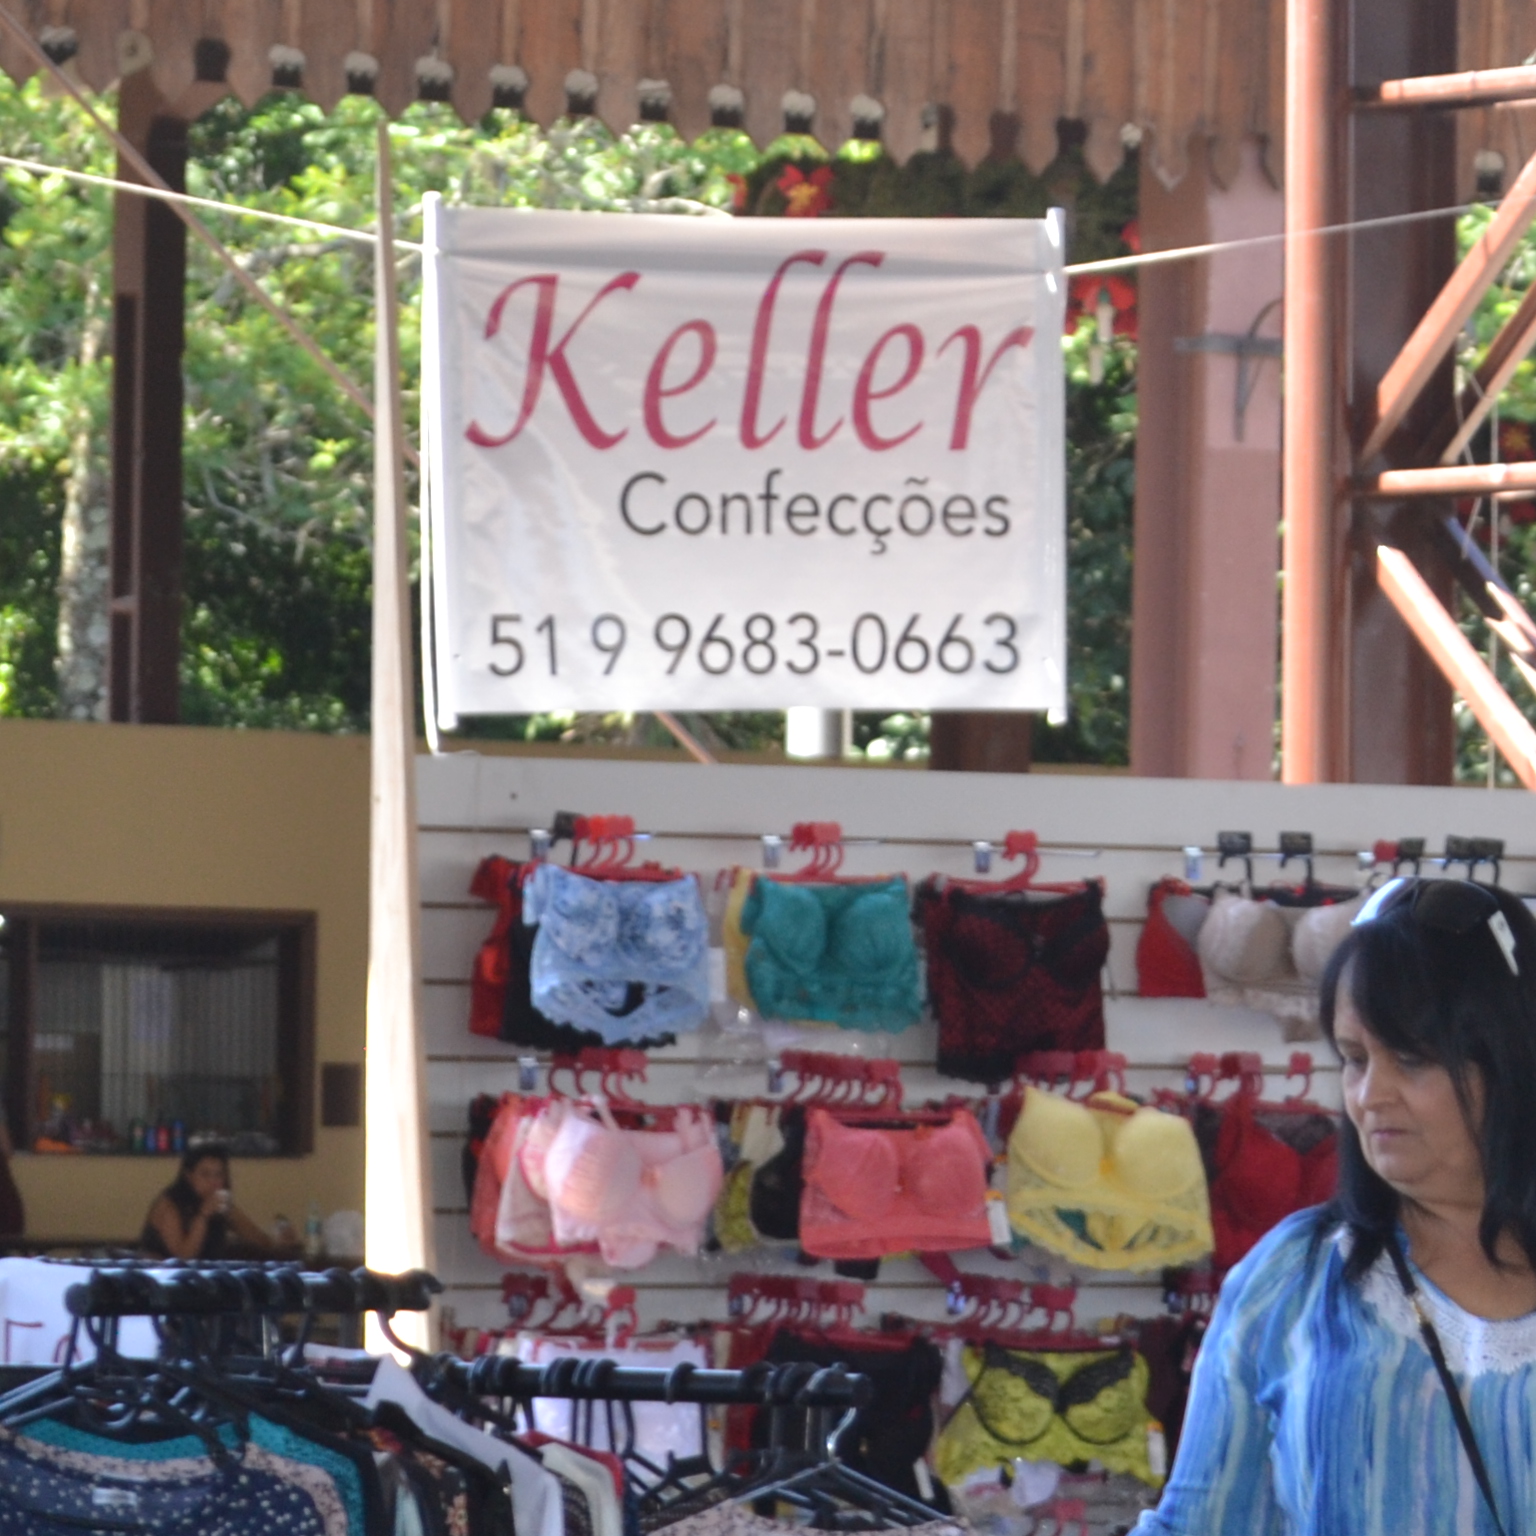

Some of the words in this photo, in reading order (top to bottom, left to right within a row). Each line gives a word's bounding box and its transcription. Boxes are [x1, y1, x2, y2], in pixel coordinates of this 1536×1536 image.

[464, 250, 1035, 452] Keller
[619, 467, 1012, 556] Confecções
[488, 613, 559, 678] 51
[590, 613, 627, 678] 9
[653, 613, 1020, 678] 9683-0663
